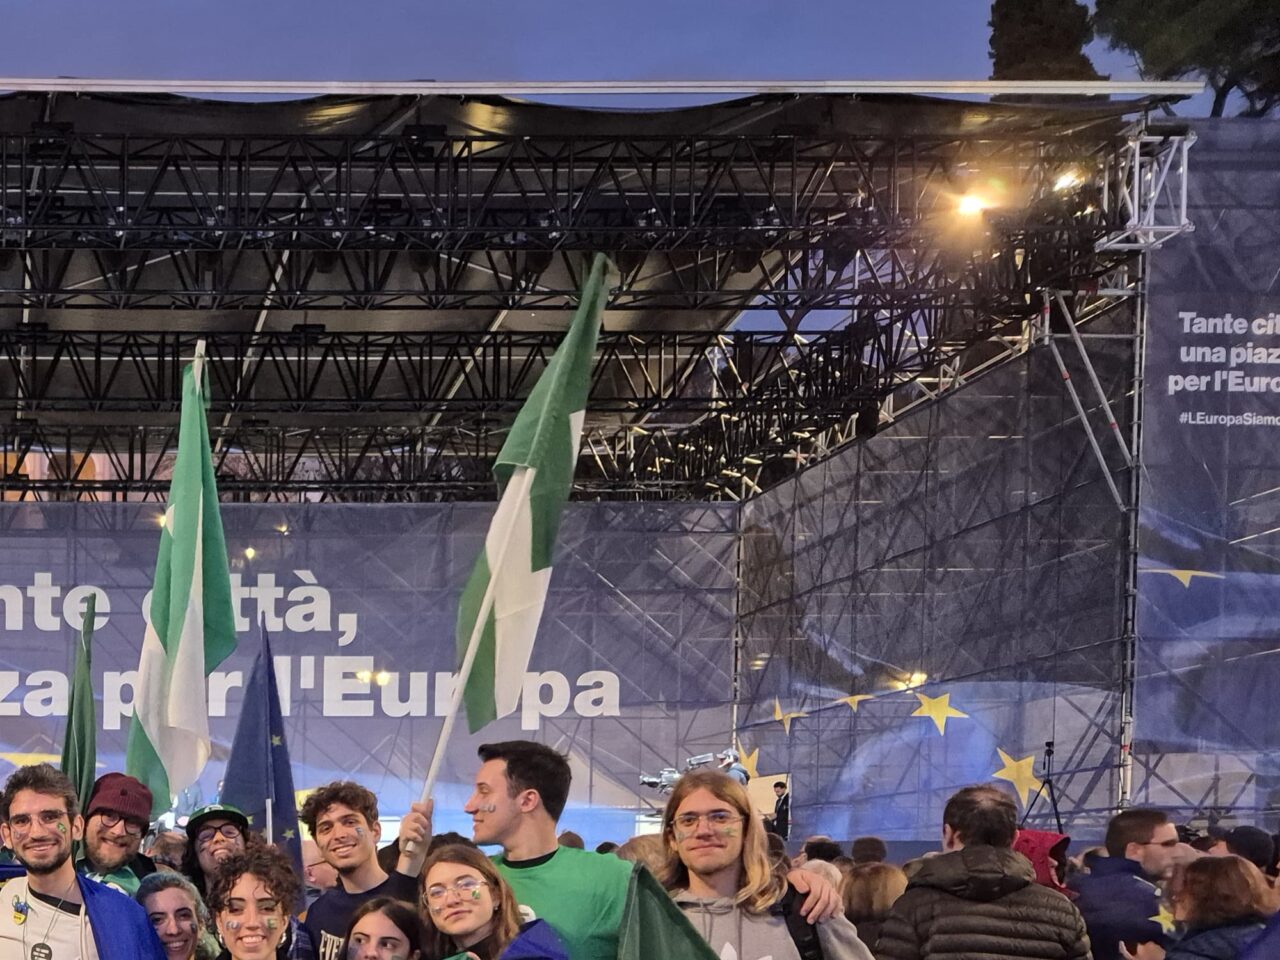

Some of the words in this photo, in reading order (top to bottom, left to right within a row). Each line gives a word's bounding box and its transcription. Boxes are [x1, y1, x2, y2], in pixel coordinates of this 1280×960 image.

[1179, 311, 1248, 334] Tante
[1180, 346, 1226, 363] una
[1168, 374, 1210, 395] per
[141, 569, 358, 647] ttà,
[102, 671, 243, 730] pr
[273, 655, 620, 731] l'Eurpa
